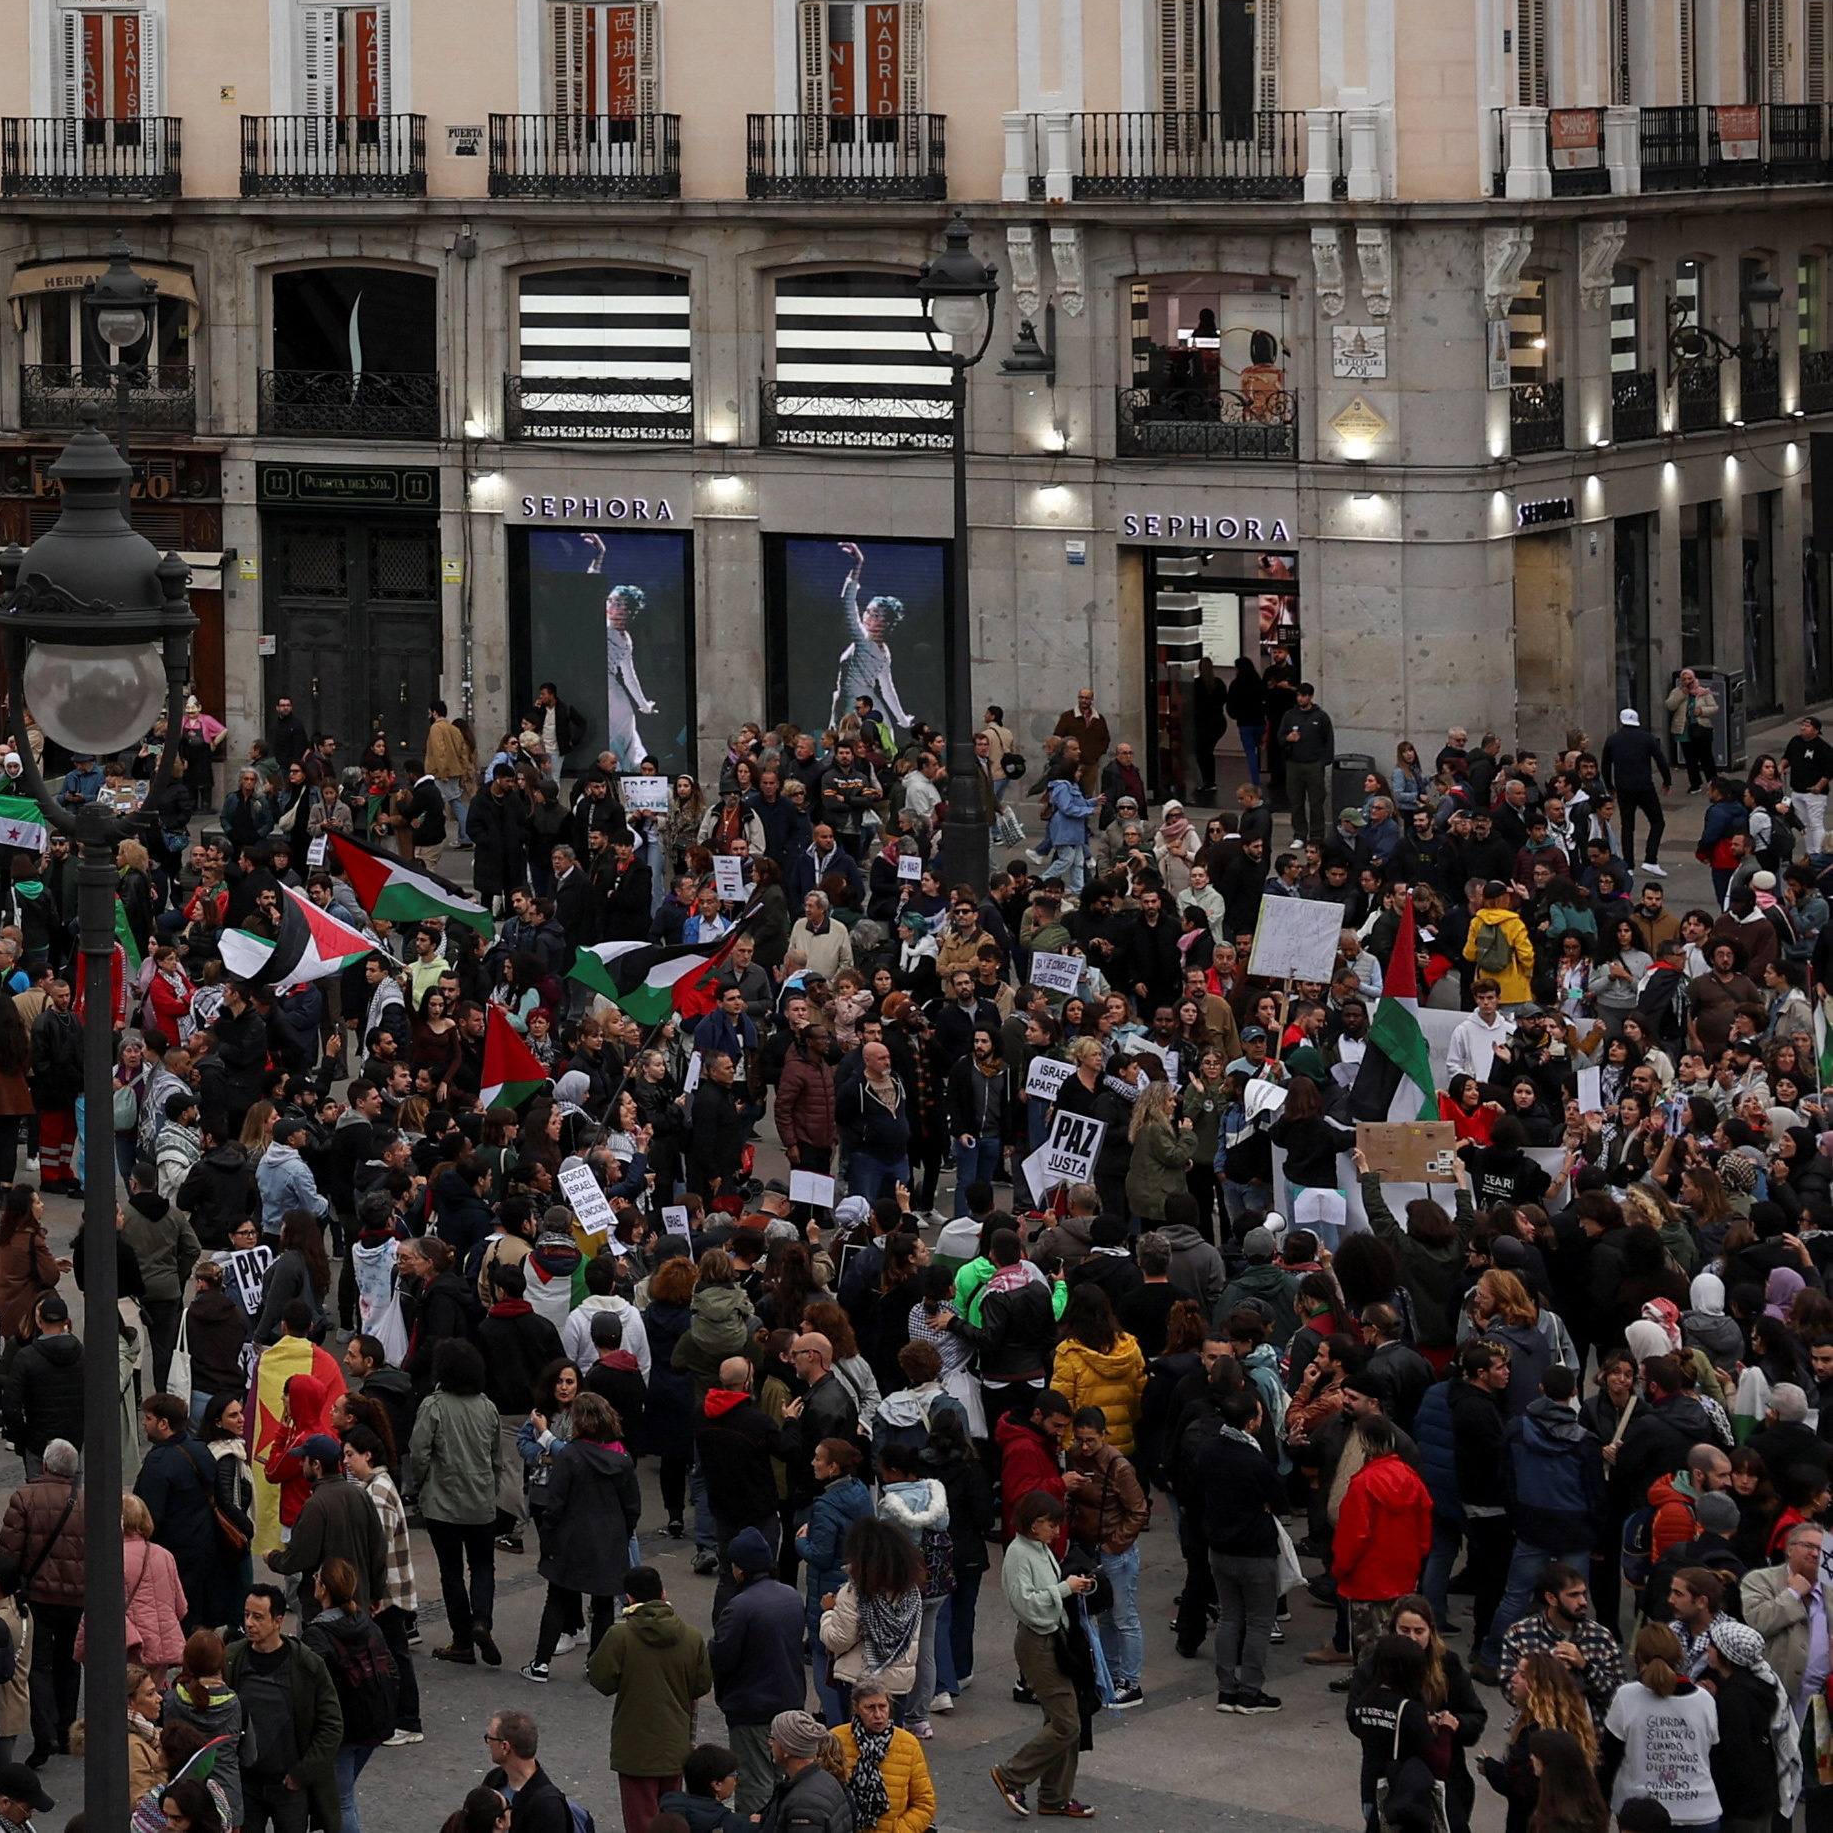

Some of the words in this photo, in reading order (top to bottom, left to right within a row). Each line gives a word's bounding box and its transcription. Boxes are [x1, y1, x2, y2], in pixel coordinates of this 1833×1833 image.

[614, 10, 636, 117] 西班牙语
[876, 7, 892, 115] MADRID
[448, 128, 483, 138] PUERTA
[1335, 358, 1370, 367] PUERTA
[1372, 358, 1383, 366] DEL
[1346, 366, 1372, 377] SOL
[270, 475, 286, 490] 11
[305, 474, 345, 489] PUERTA
[348, 478, 369, 489] DEL
[370, 475, 391, 490] SOL
[410, 479, 425, 494] 11
[522, 495, 674, 521] SEPHORA
[1124, 513, 1291, 541] SEPHORA
[1052, 1114, 1098, 1157] PAZ
[1047, 1153, 1086, 1176] JUSTA
[560, 1166, 589, 1184] BOICOT
[236, 1248, 269, 1290] PAZ
[1646, 1715, 1688, 1728] GUARDA
[1646, 1727, 1696, 1741] SILENCIO
[1646, 1740, 1683, 1752] CUANDO
[1646, 1751, 1666, 1762] LOS
[1669, 1749, 1699, 1763] NIÑOS
[1646, 1763, 1698, 1774] DUERMEN
[1646, 1780, 1689, 1790] CUANDO
[1648, 1788, 1698, 1801] MUEREN
